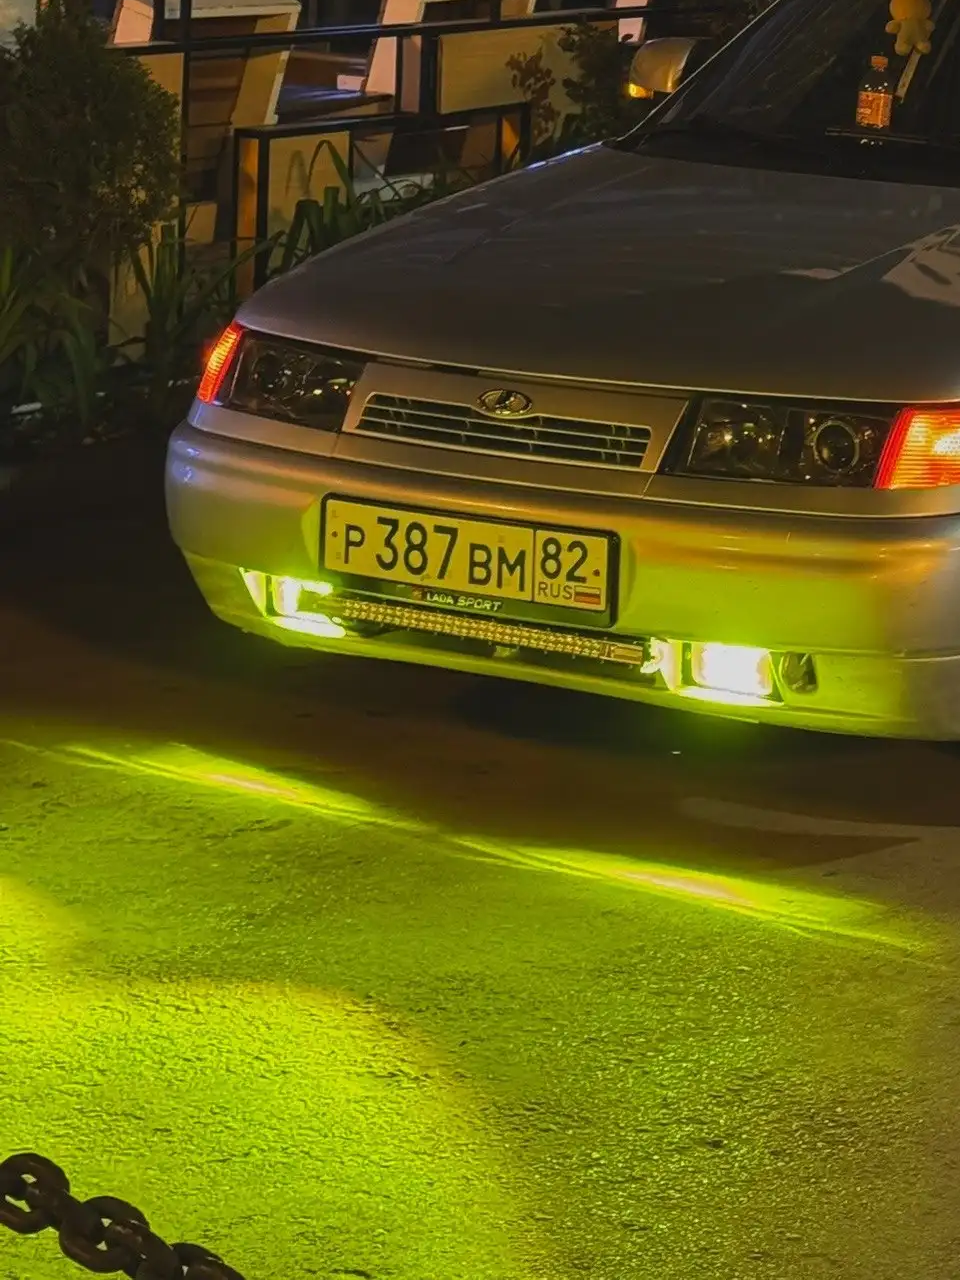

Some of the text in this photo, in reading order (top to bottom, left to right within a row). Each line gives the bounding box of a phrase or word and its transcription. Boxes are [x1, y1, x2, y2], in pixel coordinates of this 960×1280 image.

[540, 536, 589, 584] 82
[537, 581, 574, 601] RUS
[425, 592, 503, 612] LADA SPORT
